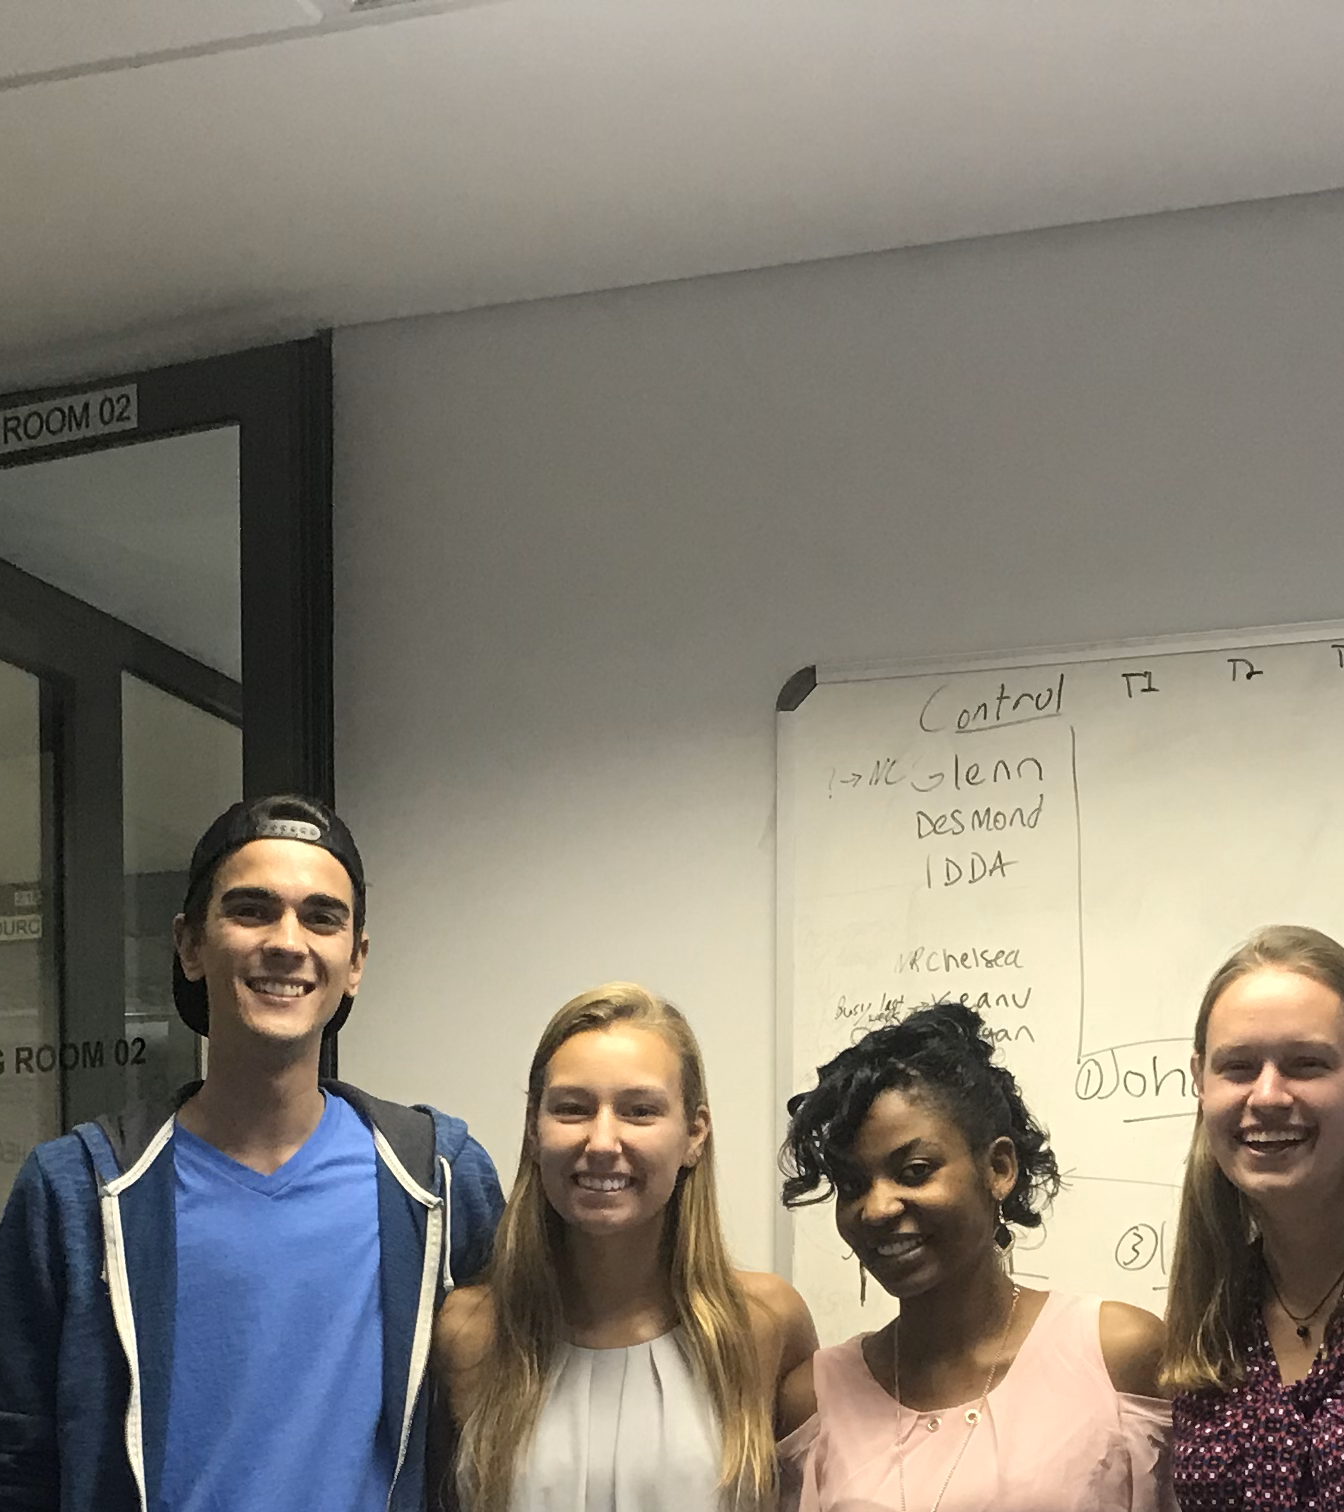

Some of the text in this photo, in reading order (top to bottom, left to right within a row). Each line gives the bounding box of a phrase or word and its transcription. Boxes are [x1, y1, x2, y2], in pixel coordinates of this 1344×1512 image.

[3, 402, 91, 446] ROOM
[98, 393, 132, 427] 02
[919, 672, 1065, 733] Control
[1227, 658, 1264, 681] T2
[14, 1040, 105, 1075] ROOM
[114, 1037, 147, 1067] 02
